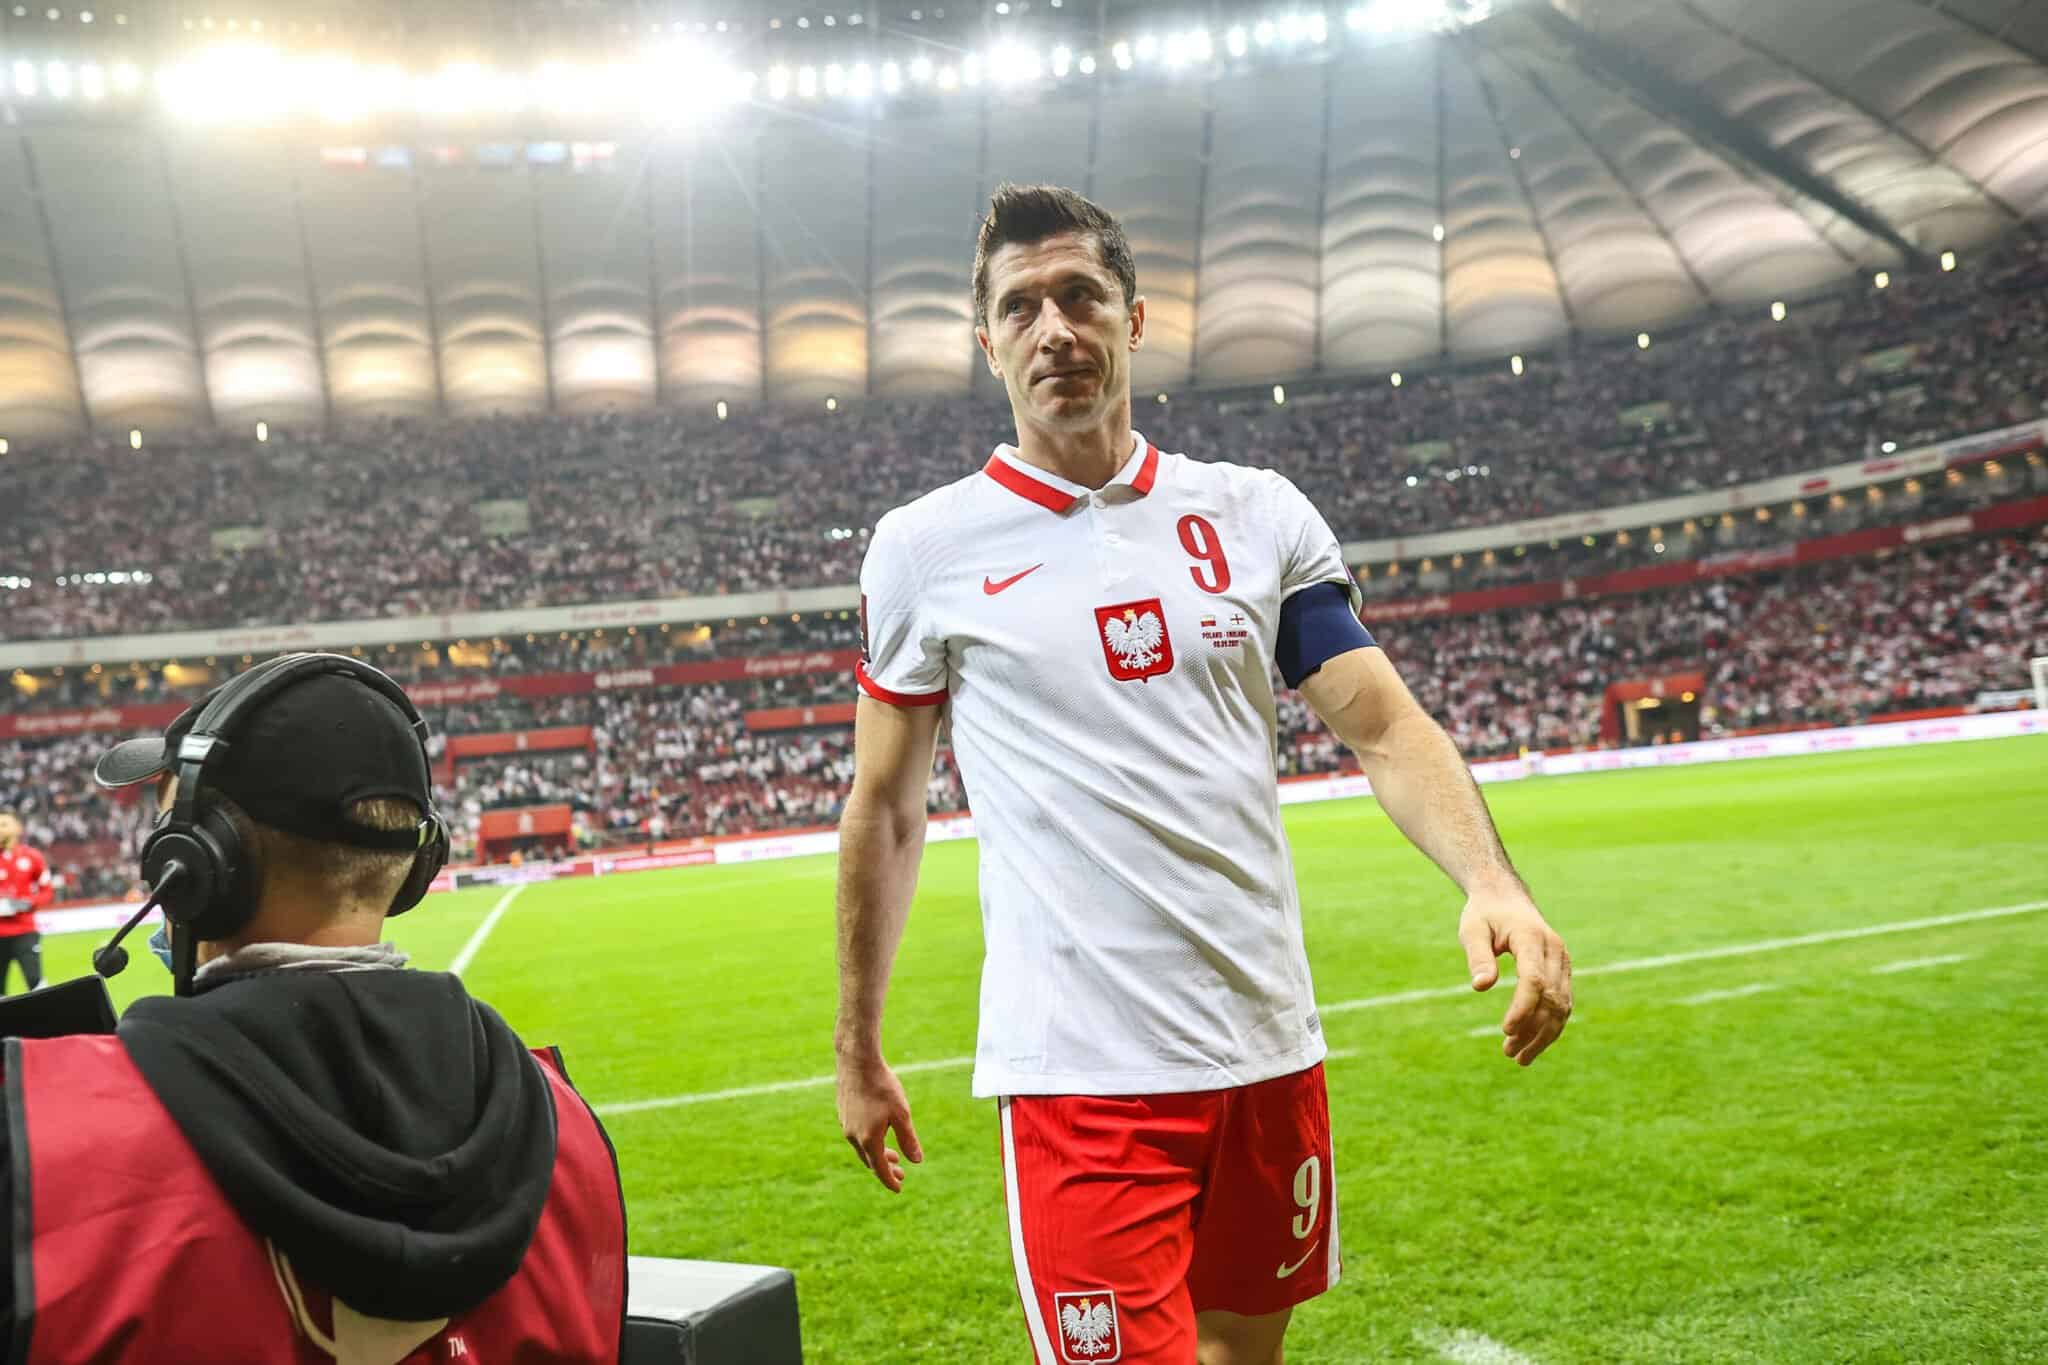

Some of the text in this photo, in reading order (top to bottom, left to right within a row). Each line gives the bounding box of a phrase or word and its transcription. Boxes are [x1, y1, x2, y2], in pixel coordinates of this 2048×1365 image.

[1176, 514, 1231, 594] 9
[1293, 1155, 1320, 1239] 9
[448, 1336, 468, 1357] TM
